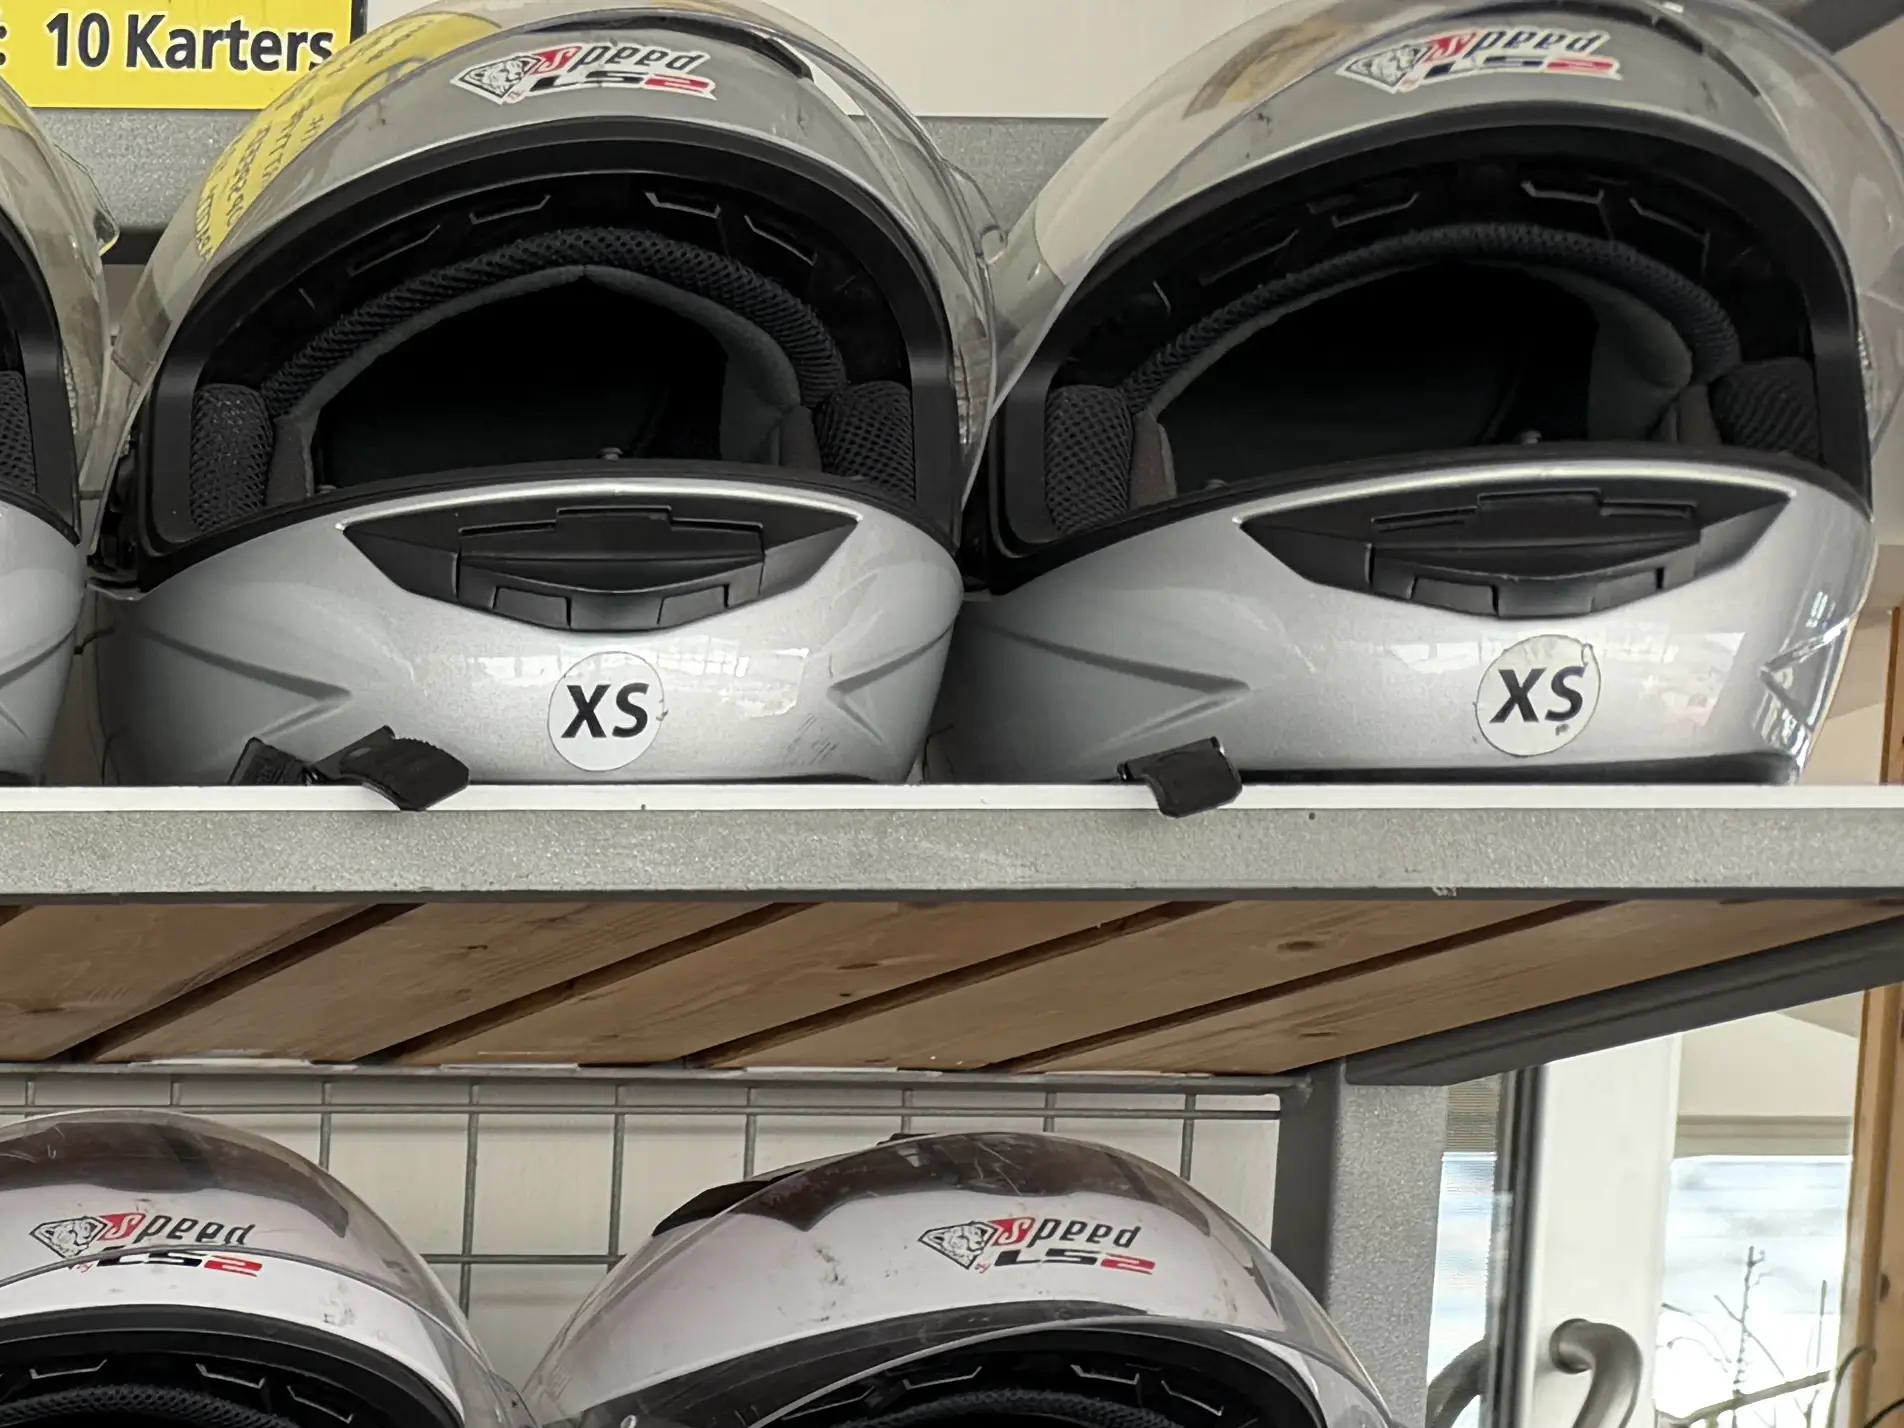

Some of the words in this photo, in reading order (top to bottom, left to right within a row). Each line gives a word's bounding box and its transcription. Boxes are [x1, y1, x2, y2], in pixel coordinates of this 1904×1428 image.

[46, 12, 111, 68] 10
[126, 14, 335, 72] Karters
[1424, 31, 1603, 60] Speed
[533, 46, 705, 73] Speed
[529, 71, 710, 92] LS2
[562, 683, 647, 737] XS
[1491, 667, 1582, 722] XS
[97, 1213, 256, 1246] Speed
[992, 1217, 1142, 1248] Speed
[994, 1248, 1156, 1275] LS2
